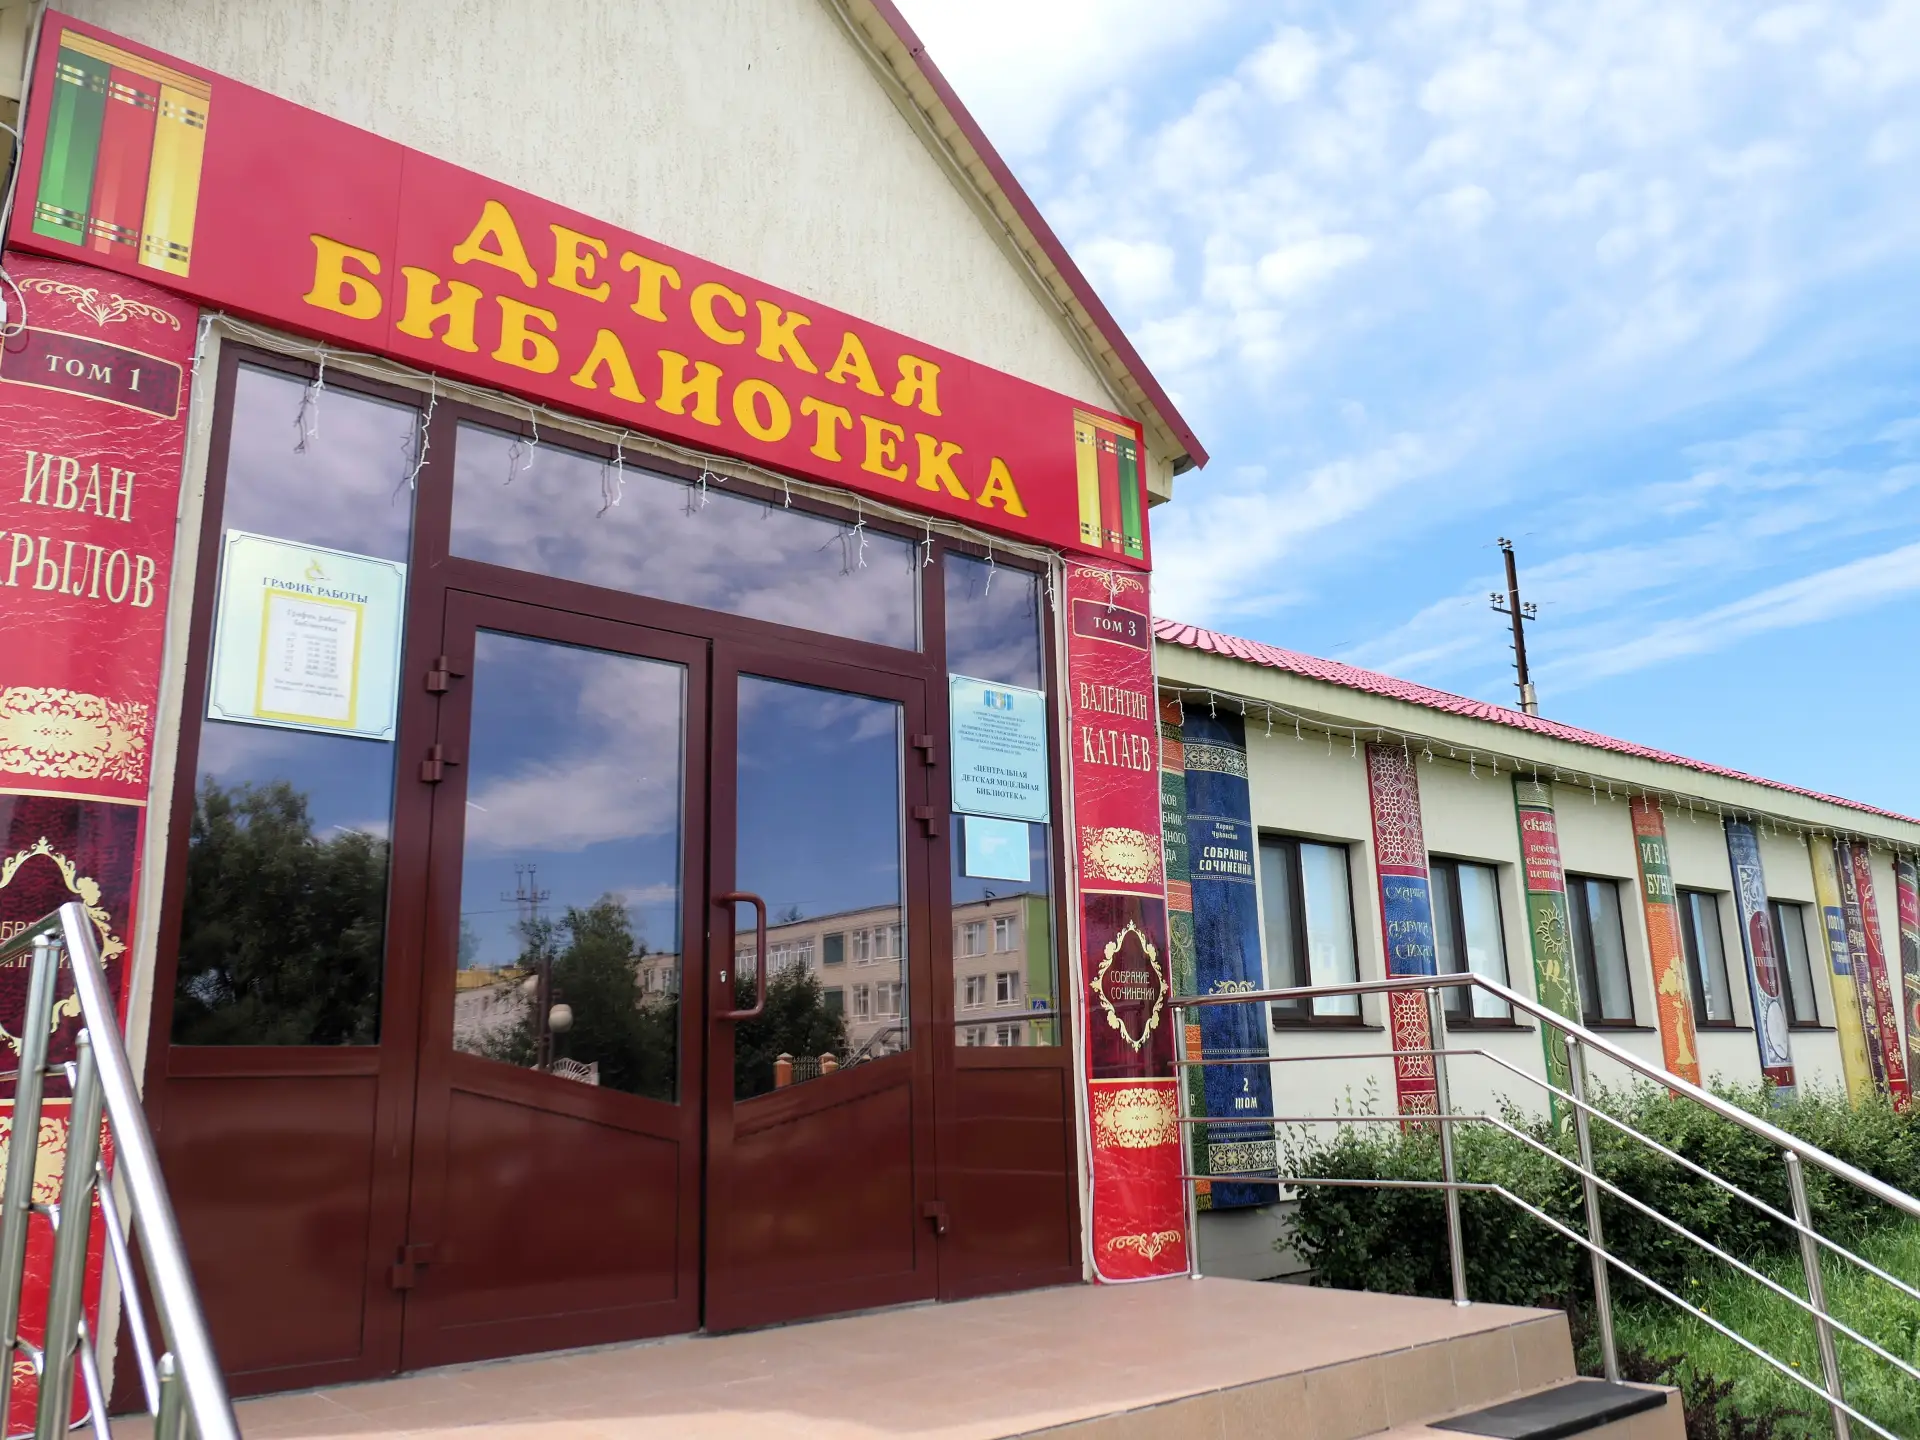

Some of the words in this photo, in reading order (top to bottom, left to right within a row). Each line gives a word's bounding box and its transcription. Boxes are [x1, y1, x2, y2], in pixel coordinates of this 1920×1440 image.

[453, 200, 942, 416] ДЕТСКАЯ
[128, 368, 140, 392] 1
[303, 234, 1028, 518] БИБЛИОТЕКА
[20, 450, 136, 522] ИВАН
[262, 577, 315, 594] ГРАФИК
[317, 586, 368, 604] РАБОТЫ
[1128, 621, 1136, 637] 3
[1080, 682, 1148, 721] ВАЛЕНТИН
[1082, 726, 1151, 771] КАТАЕВ
[961, 774, 995, 785] ДЕТСКАЯ
[996, 779, 1039, 791] МОДЕЛЬНАЯ
[1161, 793, 1177, 807] КОВ
[1162, 811, 1182, 826] БНИК
[1162, 830, 1187, 845] ДНОГО
[1203, 846, 1248, 862] СОБРАНИЕ
[1199, 859, 1252, 876] СОЧИНЕНИЙ
[1110, 970, 1150, 984] СОБРАНИЕ
[1110, 986, 1155, 1000] СОЧИНЕНИЙ
[1243, 1077, 1249, 1092] 2
